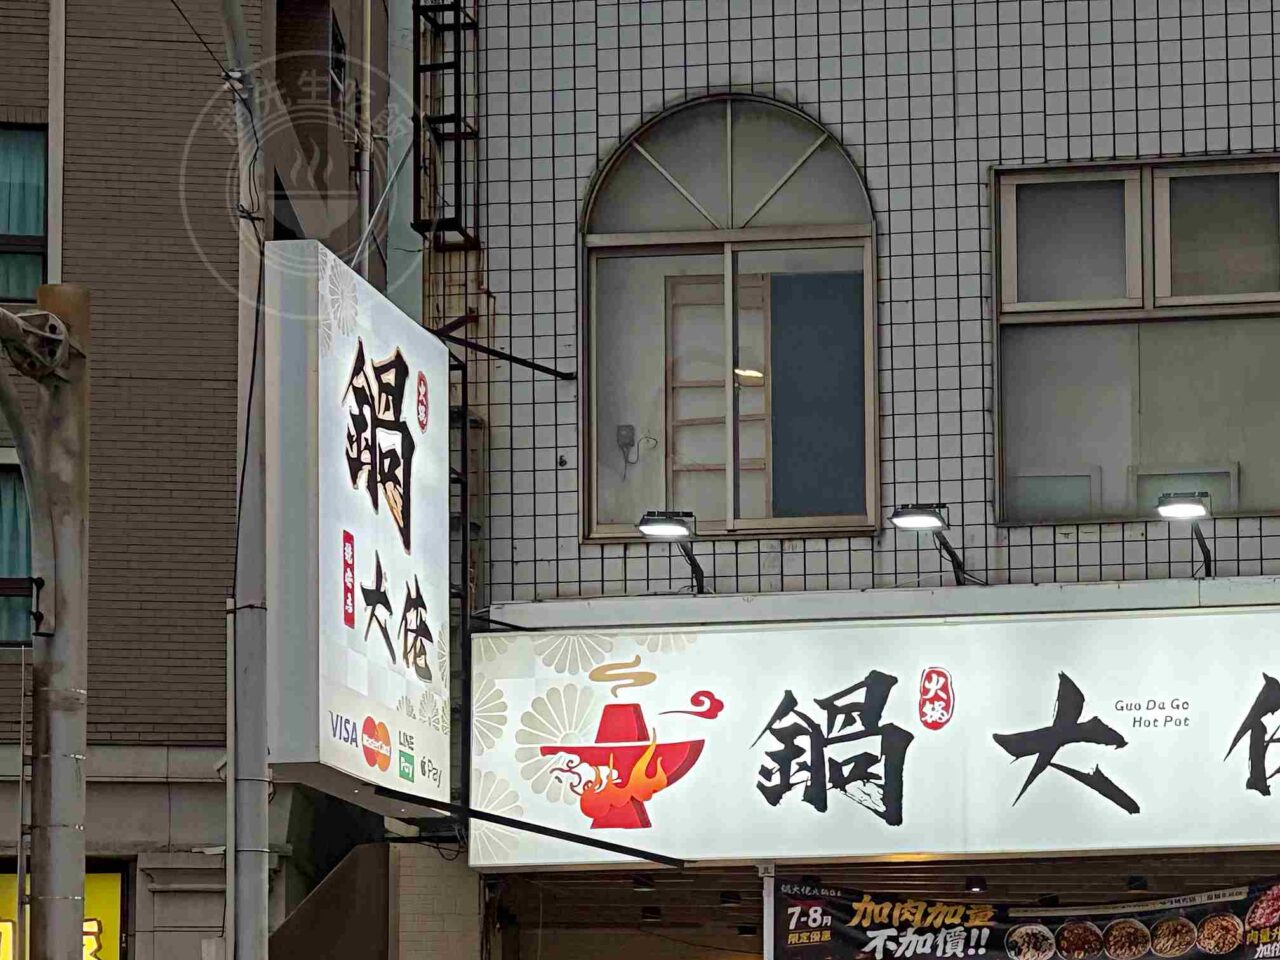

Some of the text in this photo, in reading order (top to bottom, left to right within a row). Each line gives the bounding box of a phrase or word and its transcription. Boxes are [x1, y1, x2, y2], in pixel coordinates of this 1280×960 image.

[342, 335, 416, 555] 鍋
[1114, 699, 1140, 713] Guo
[328, 710, 359, 749] VISA
[1132, 715, 1190, 729] Hot Pot
